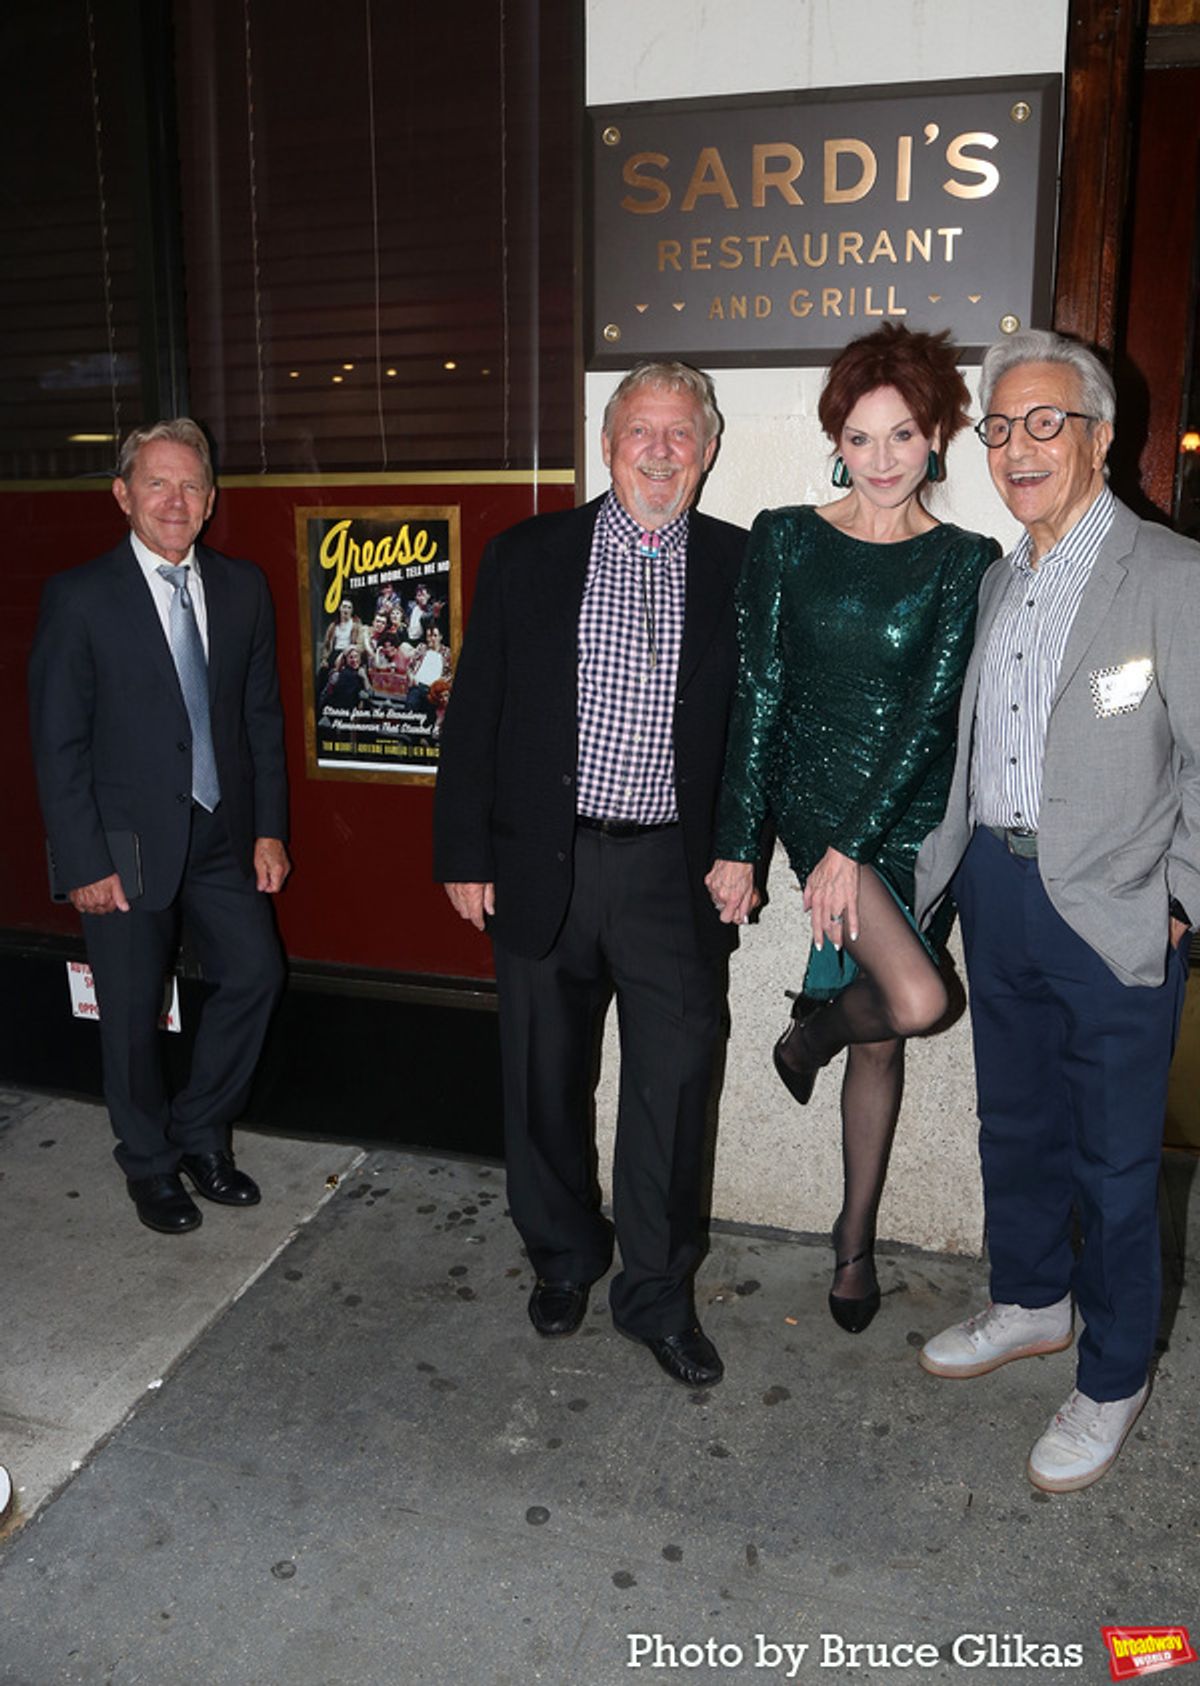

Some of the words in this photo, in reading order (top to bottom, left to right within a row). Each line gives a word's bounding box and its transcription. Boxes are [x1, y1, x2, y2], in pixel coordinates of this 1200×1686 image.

[621, 122, 1001, 215] SARDI'S
[657, 227, 963, 272] RESTAURANT
[708, 294, 772, 320] AND
[789, 286, 907, 318] GRILL
[350, 576, 365, 589] TELL
[367, 573, 379, 586] ME
[406, 564, 421, 579] TELL
[424, 562, 435, 575] ME
[350, 707, 371, 721] from
[372, 708, 385, 719] the
[386, 708, 428, 727] Broadway
